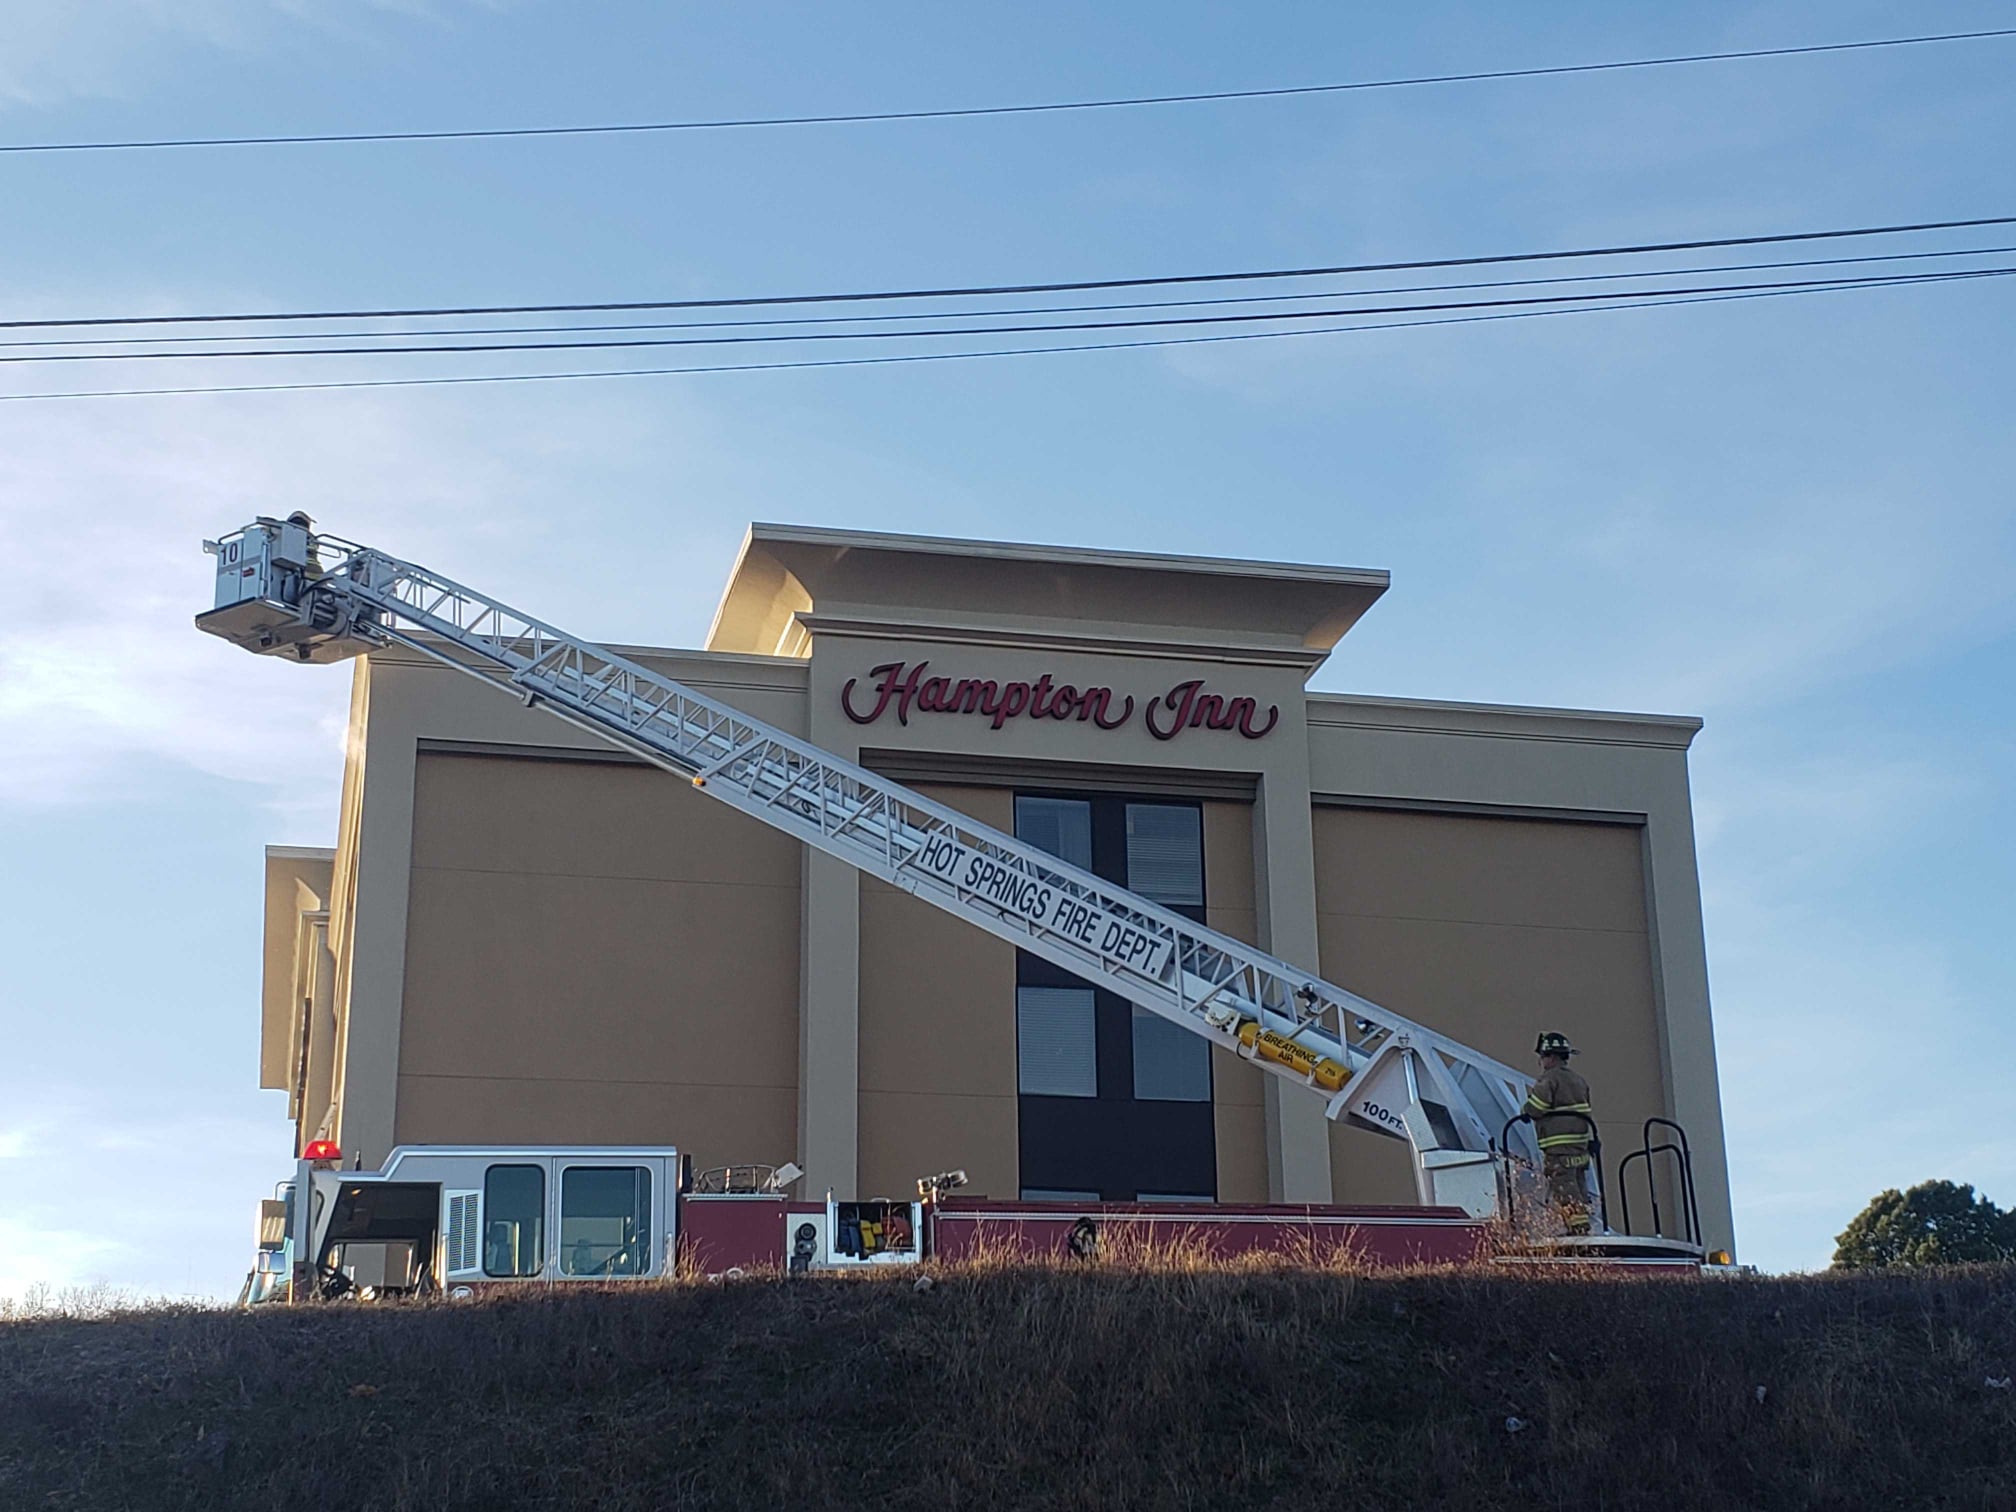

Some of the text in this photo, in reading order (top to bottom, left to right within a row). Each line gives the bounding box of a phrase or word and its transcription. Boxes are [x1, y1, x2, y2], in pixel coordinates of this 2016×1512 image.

[220, 543, 238, 565] 10
[841, 660, 1279, 741] Hampton Inn
[920, 835, 1161, 974] HOT SPRINGS FIRE DEPT.
[1263, 1033, 1316, 1064] BREATHING
[1278, 1050, 1294, 1064] AIR
[1363, 1101, 1403, 1130] 100 FT.
